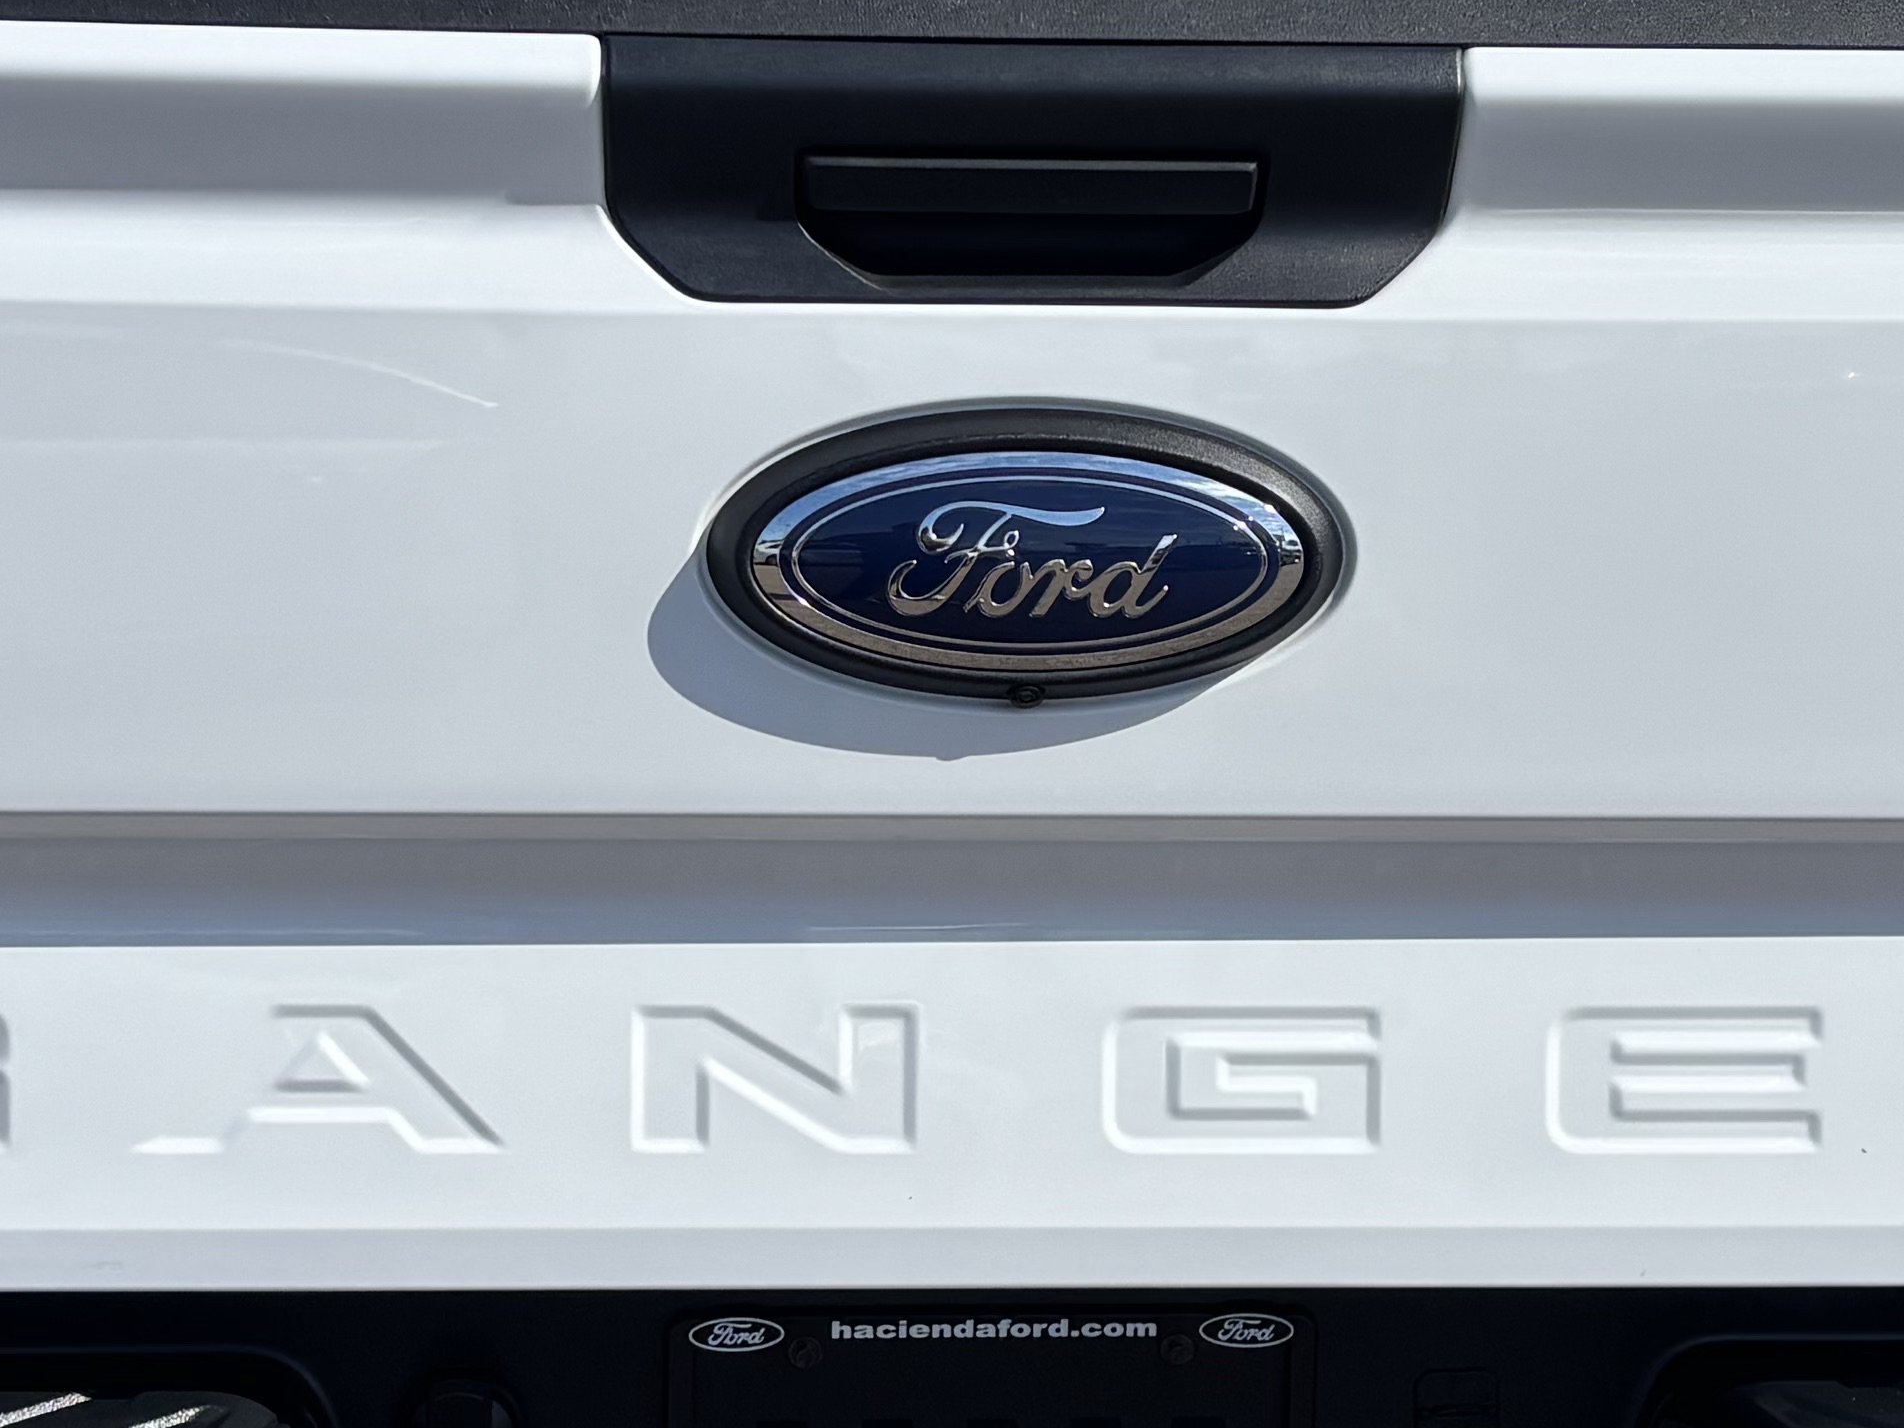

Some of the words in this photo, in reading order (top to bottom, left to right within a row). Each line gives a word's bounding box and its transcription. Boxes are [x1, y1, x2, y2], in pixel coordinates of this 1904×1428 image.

[888, 500, 1178, 618] Ford
[707, 1321, 765, 1347] Ford
[831, 1317, 1158, 1340] haciendaford.com
[1217, 1316, 1274, 1343] Ford
